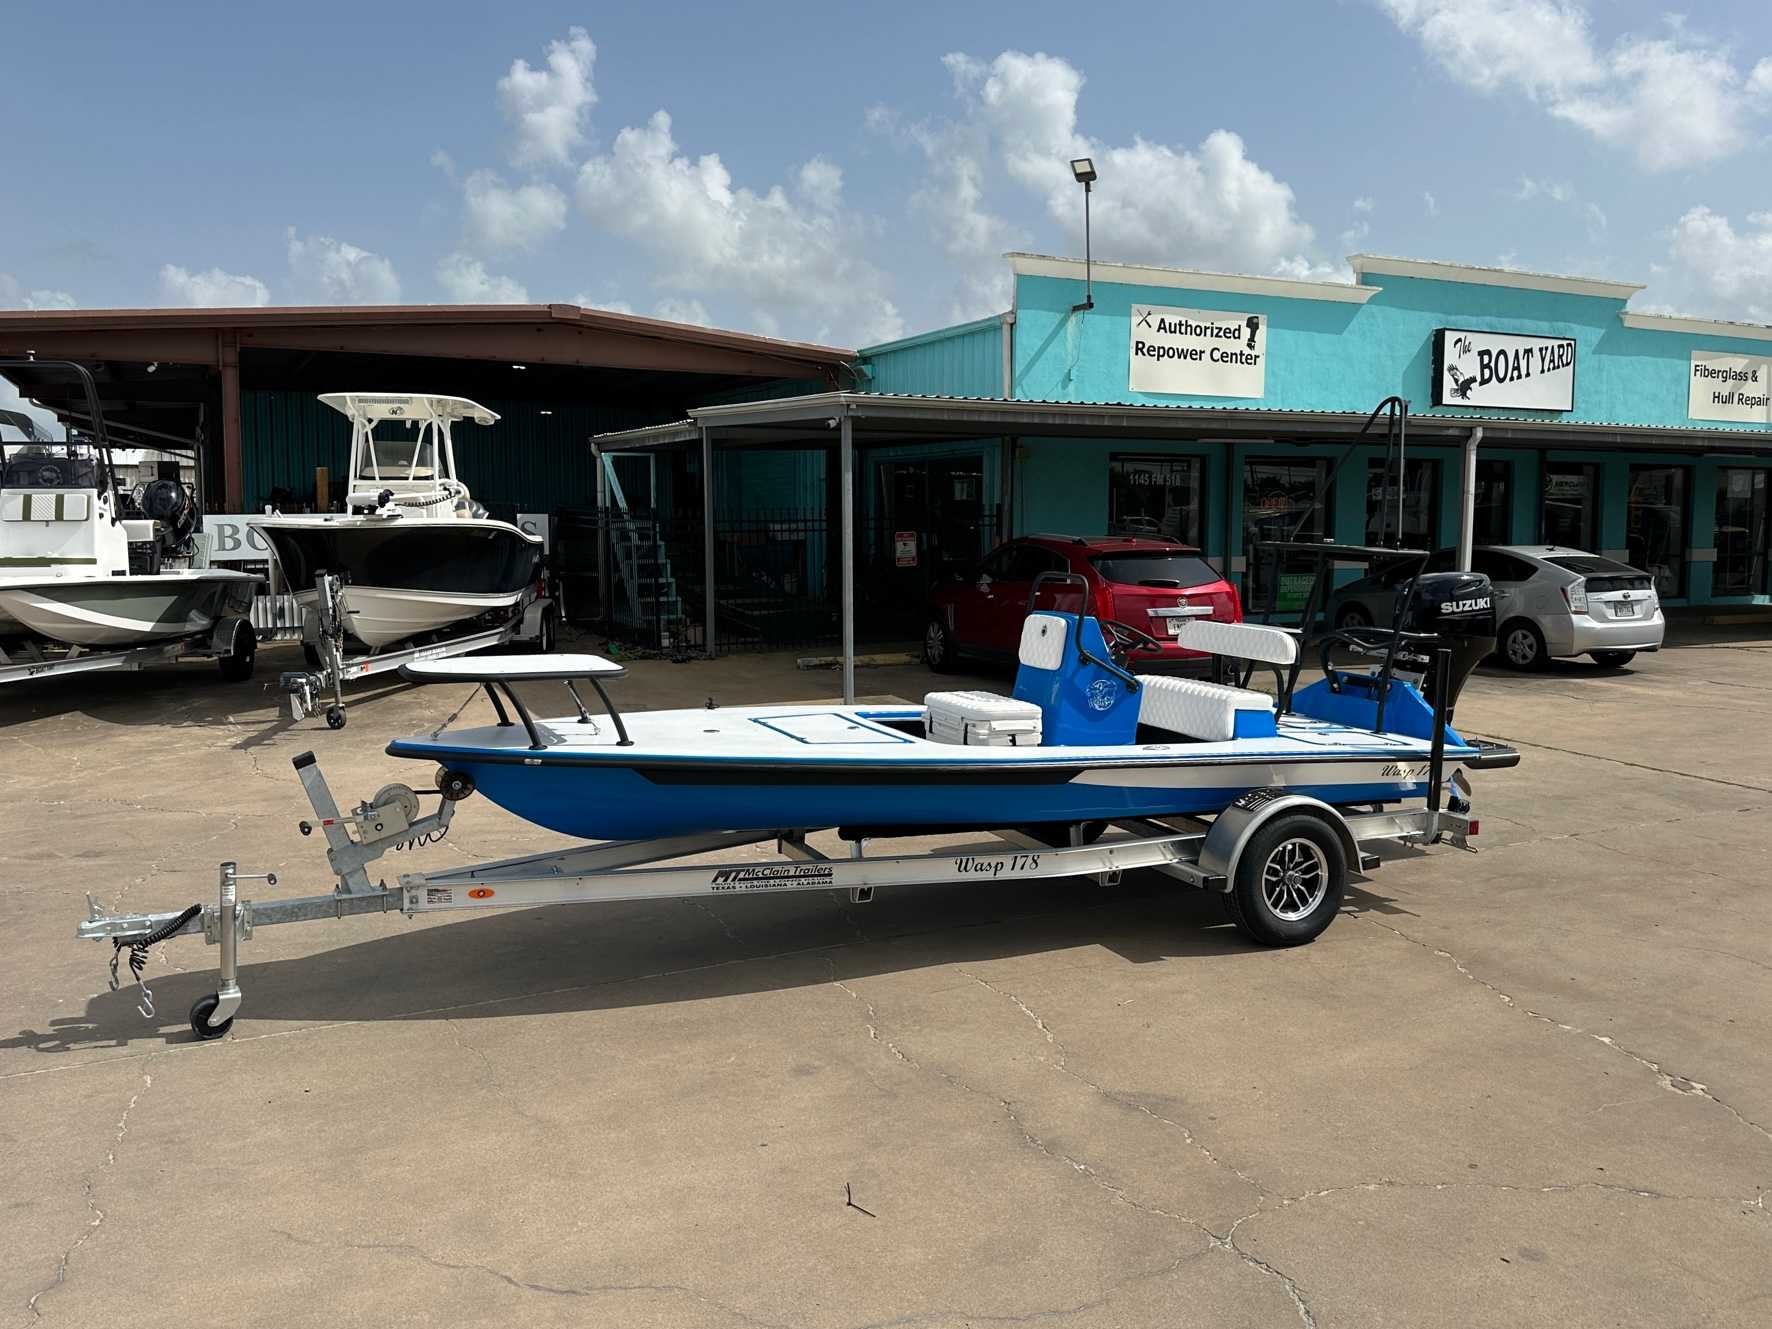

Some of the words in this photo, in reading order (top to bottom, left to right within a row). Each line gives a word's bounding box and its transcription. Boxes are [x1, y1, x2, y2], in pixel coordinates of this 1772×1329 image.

[1157, 318, 1242, 341] Authorized
[1134, 340, 1206, 362] Repower
[1209, 347, 1261, 366] Center
[1453, 335, 1473, 360] The
[1477, 347, 1534, 387] BOAT
[1538, 342, 1574, 375] YARD
[1693, 364, 1749, 383] Fiberglass
[1750, 370, 1759, 383] &
[1712, 391, 1735, 405] Hull
[1737, 393, 1771, 409] Repair
[1129, 472, 1150, 486] 1145
[1440, 597, 1491, 613] SUZUKI
[1381, 764, 1415, 779] Wasp
[1416, 764, 1432, 776] 17
[743, 867, 790, 878] McClain
[793, 864, 833, 875] Trailers
[954, 857, 1004, 876] Wasp
[1010, 854, 1040, 871] 178
